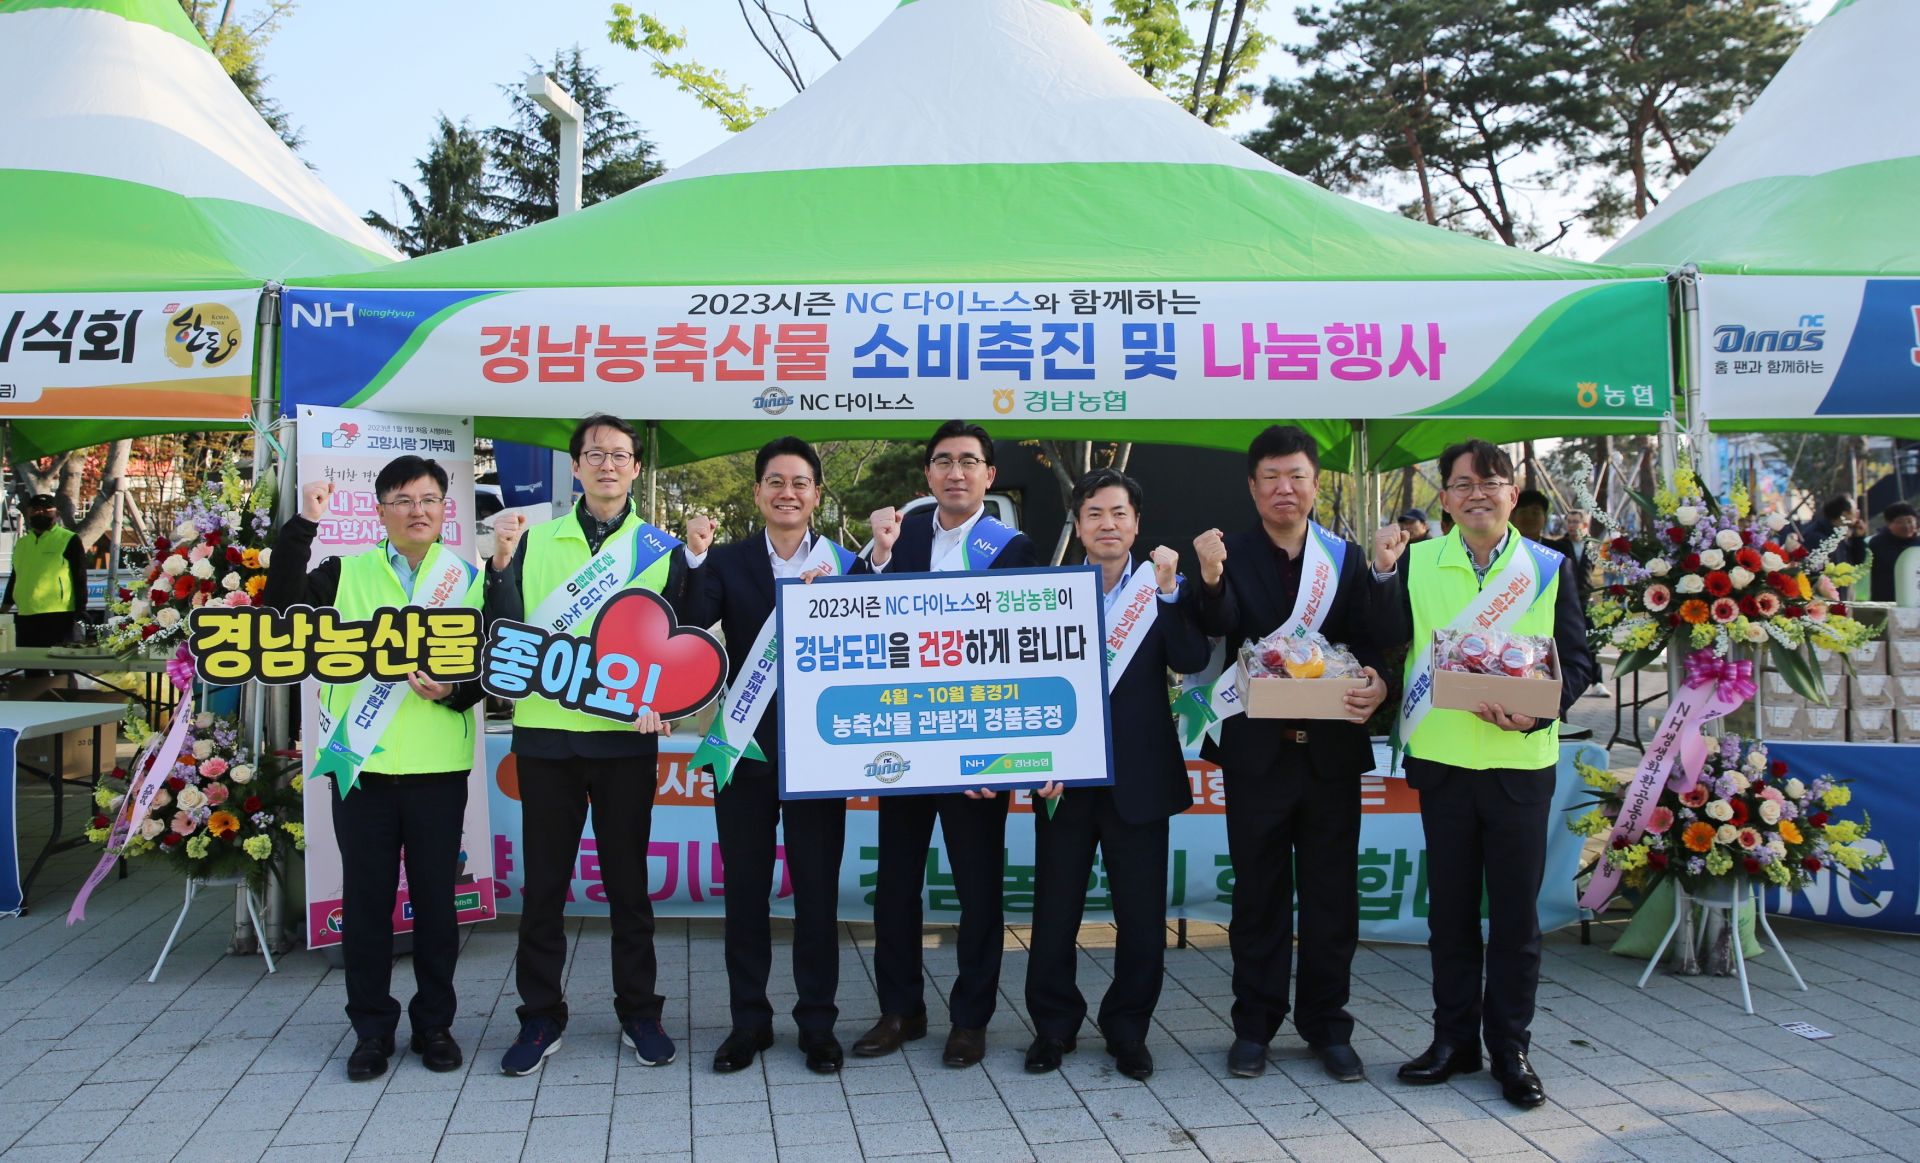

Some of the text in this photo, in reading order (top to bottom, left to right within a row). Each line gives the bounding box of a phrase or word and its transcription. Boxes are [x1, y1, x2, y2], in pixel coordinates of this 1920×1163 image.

[290, 302, 415, 328] NH NongHyup
[688, 289, 1200, 317] 2023시즌 NC 다이노스와 함께하는
[480, 320, 1447, 383] 경남농축산물 소비촉진 및 나눔행사
[1715, 360, 1824, 375] 홈 팬과 함께하는
[800, 392, 914, 412] NC 다이노스
[1023, 390, 1127, 413] 경남농협
[1604, 384, 1654, 408] 농협
[367, 424, 391, 433] 2023년
[393, 425, 402, 433] 1월
[404, 426, 414, 434] 1일
[367, 436, 455, 453] 고향사랑 기부제
[643, 533, 667, 553] NH
[973, 538, 998, 555] NH
[1320, 527, 1343, 543] NH
[1532, 543, 1558, 560] NH
[808, 587, 1073, 619] 2023시즌 NC 다이노스와 경남농협이
[1301, 560, 1330, 628] 고향사랑기부제
[1106, 584, 1156, 650] 고향사랑기부제
[197, 613, 479, 679] 경남농산물
[795, 631, 911, 673] 경남도민을
[918, 627, 1010, 668] 건강하게
[1016, 624, 1087, 663] 합니다
[488, 626, 663, 717] 좋아요!
[730, 669, 767, 724] 함께합니다
[879, 688, 908, 706] 4월
[928, 686, 965, 704] 10월
[970, 683, 1020, 702] 홈경기
[832, 704, 1063, 738] 농축산물 관람객 경품증정
[965, 759, 985, 768] NH
